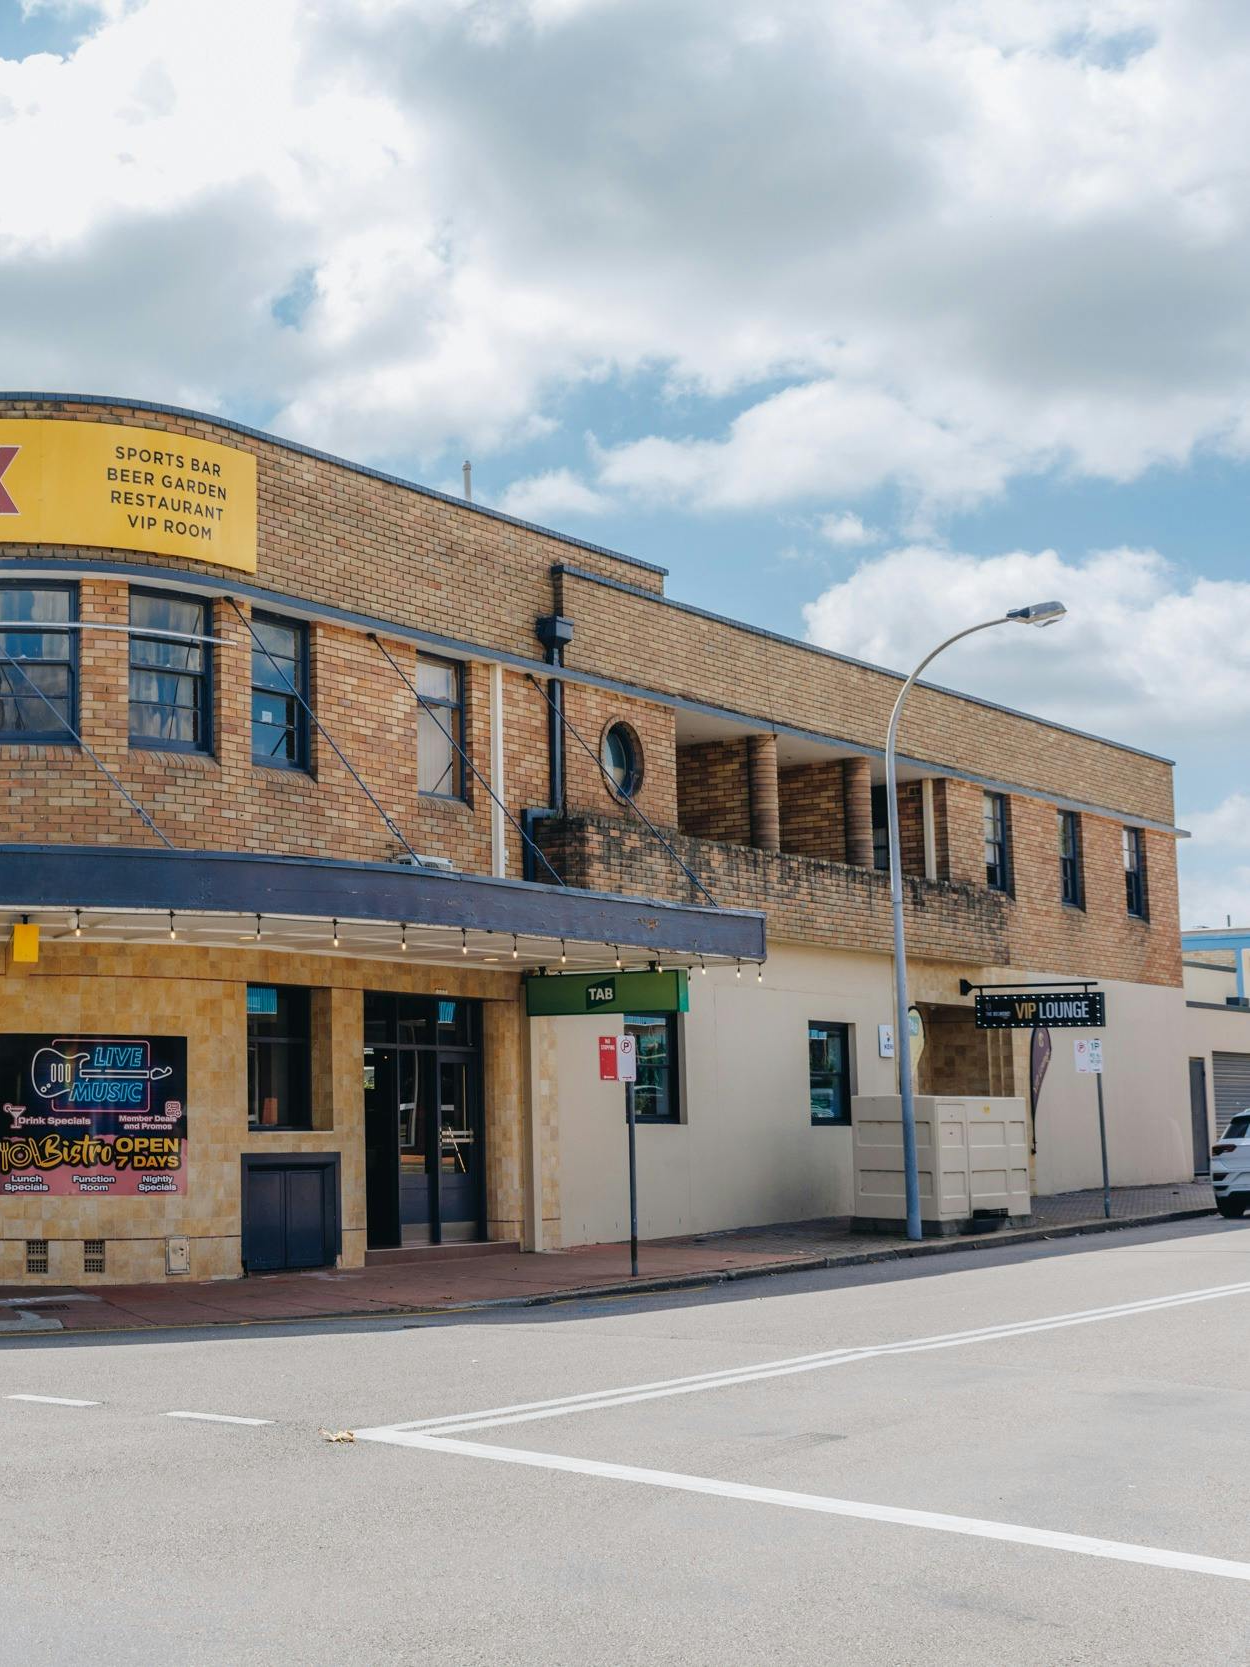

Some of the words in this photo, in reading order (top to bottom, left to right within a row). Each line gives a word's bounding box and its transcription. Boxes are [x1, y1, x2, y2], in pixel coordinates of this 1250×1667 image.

[115, 446, 184, 469] SPORTS
[191, 458, 221, 477] BAR
[107, 467, 154, 486] BEER
[161, 475, 227, 500] GARDEN
[111, 490, 223, 521] RESTAURANT
[128, 514, 157, 530] VIP
[164, 520, 212, 540] ROOM
[588, 988, 614, 1000] TAB
[1015, 1002, 1037, 1019] VIP
[1038, 1001, 1090, 1019] LOUNGE
[94, 1047, 143, 1067] LIVE
[69, 1082, 143, 1103] MUSIC
[18, 1116, 46, 1125] Drink
[47, 1117, 92, 1126] Specials
[118, 1115, 153, 1123] Member
[154, 1115, 177, 1123] Deals
[123, 1122, 140, 1130] and
[141, 1123, 173, 1131] Promos
[39, 1133, 112, 1168] Bistro
[115, 1138, 179, 1153] OPEN
[116, 1156, 129, 1168] 7
[133, 1156, 179, 1168] DAYS
[11, 1175, 42, 1183] Lunch
[72, 1175, 116, 1183] Function
[142, 1175, 174, 1185] Nightly
[4, 1183, 49, 1192] Specials
[80, 1183, 109, 1191] Room
[138, 1183, 178, 1192] Specials
